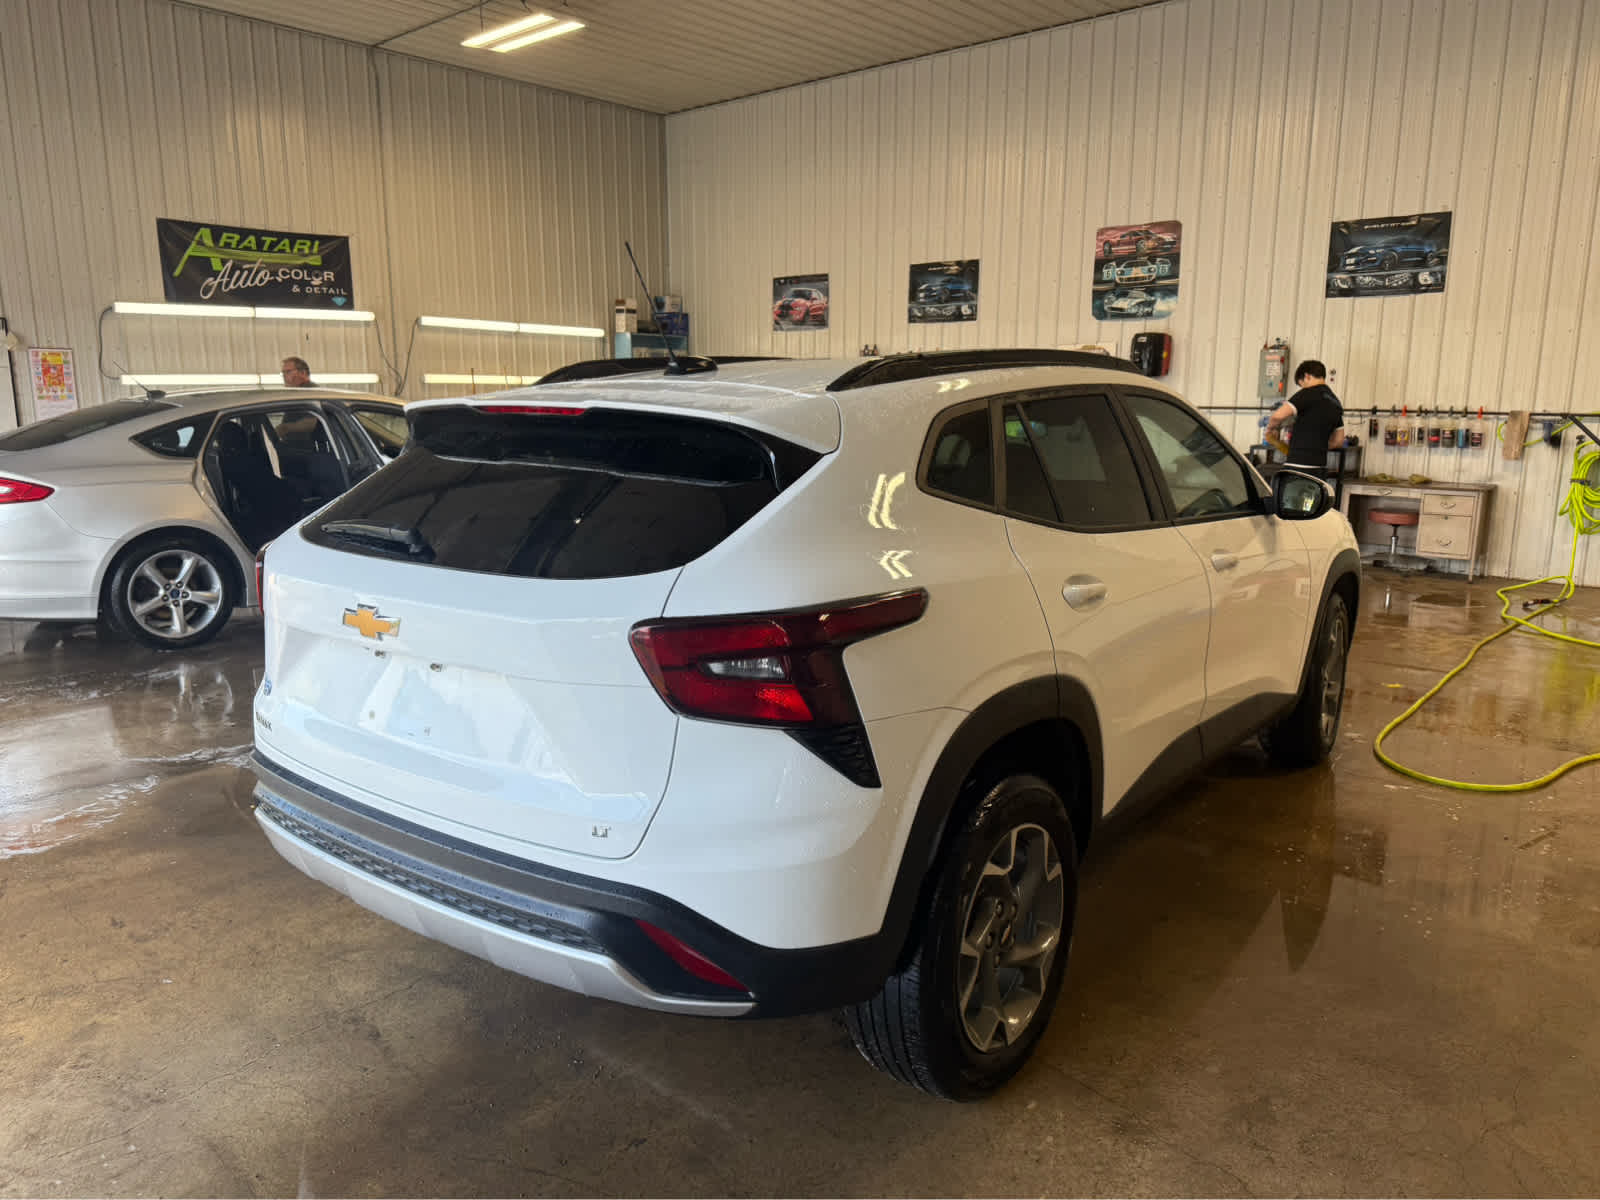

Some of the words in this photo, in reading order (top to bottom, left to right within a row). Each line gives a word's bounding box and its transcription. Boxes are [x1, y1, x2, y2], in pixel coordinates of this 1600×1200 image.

[172, 227, 321, 277] ARATARI
[200, 259, 272, 299] Auto
[278, 267, 335, 282] COLOR
[305, 286, 348, 295] DETAIL
